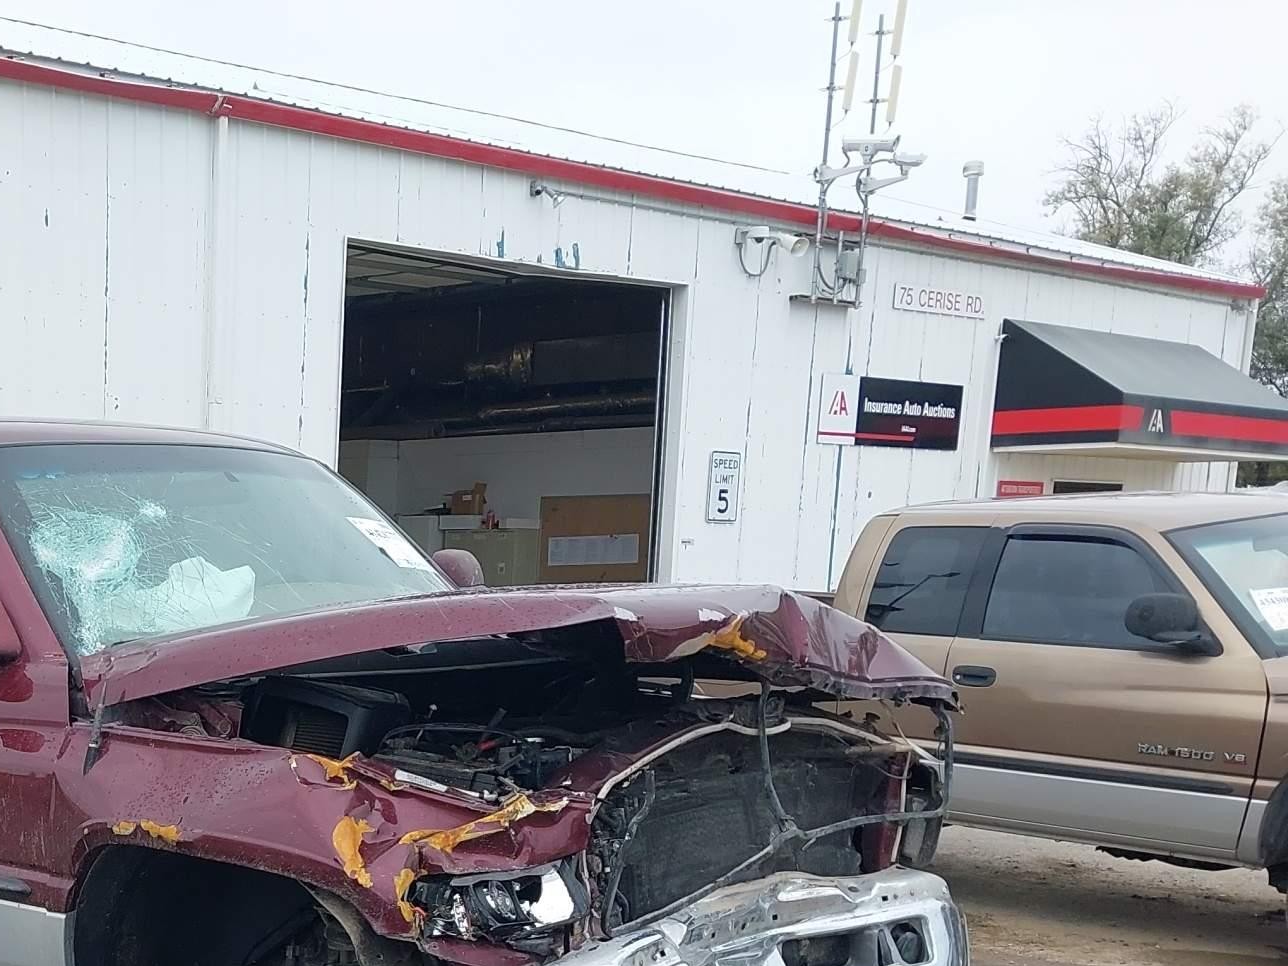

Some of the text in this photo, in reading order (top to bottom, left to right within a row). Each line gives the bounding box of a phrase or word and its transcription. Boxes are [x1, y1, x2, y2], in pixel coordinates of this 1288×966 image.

[899, 286, 985, 315] 75 CERISE RD.
[864, 397, 956, 419] Insurance Auto Auctions
[713, 458, 738, 470] SPEED
[715, 474, 735, 485] LIMIT
[717, 488, 729, 514] 5
[1137, 743, 1168, 756] RAM
[1175, 746, 1215, 761] 1500
